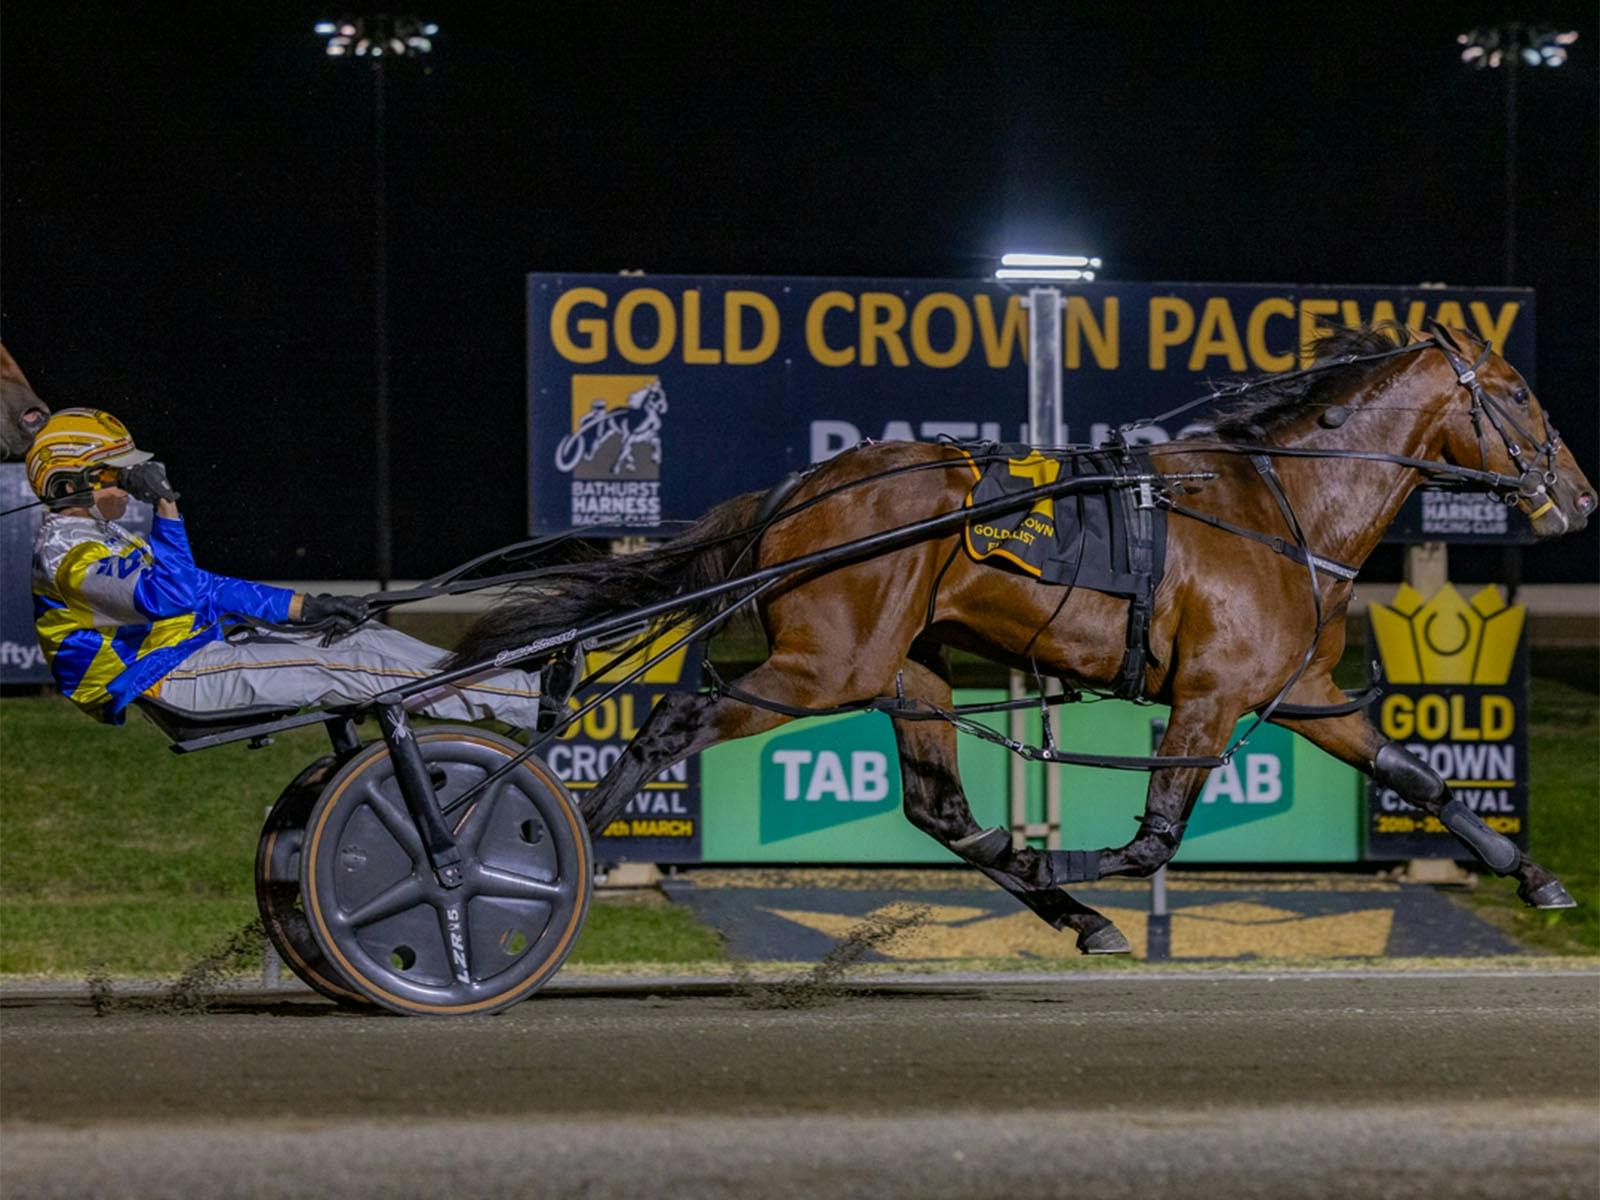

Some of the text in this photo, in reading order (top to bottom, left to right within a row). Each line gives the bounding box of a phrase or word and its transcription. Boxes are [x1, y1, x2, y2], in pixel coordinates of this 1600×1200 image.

[550, 288, 780, 364] GOLD
[805, 292, 1119, 368] CROWN
[571, 481, 661, 496] BATHURST
[571, 497, 661, 513] HARNESS
[1421, 503, 1507, 521] HARNESS
[974, 524, 1010, 540] GOLD
[555, 692, 665, 740] OL
[1381, 694, 1515, 741] GOLD
[772, 750, 889, 801] TAB
[1202, 753, 1282, 804] AB
[632, 820, 693, 836] MARCH
